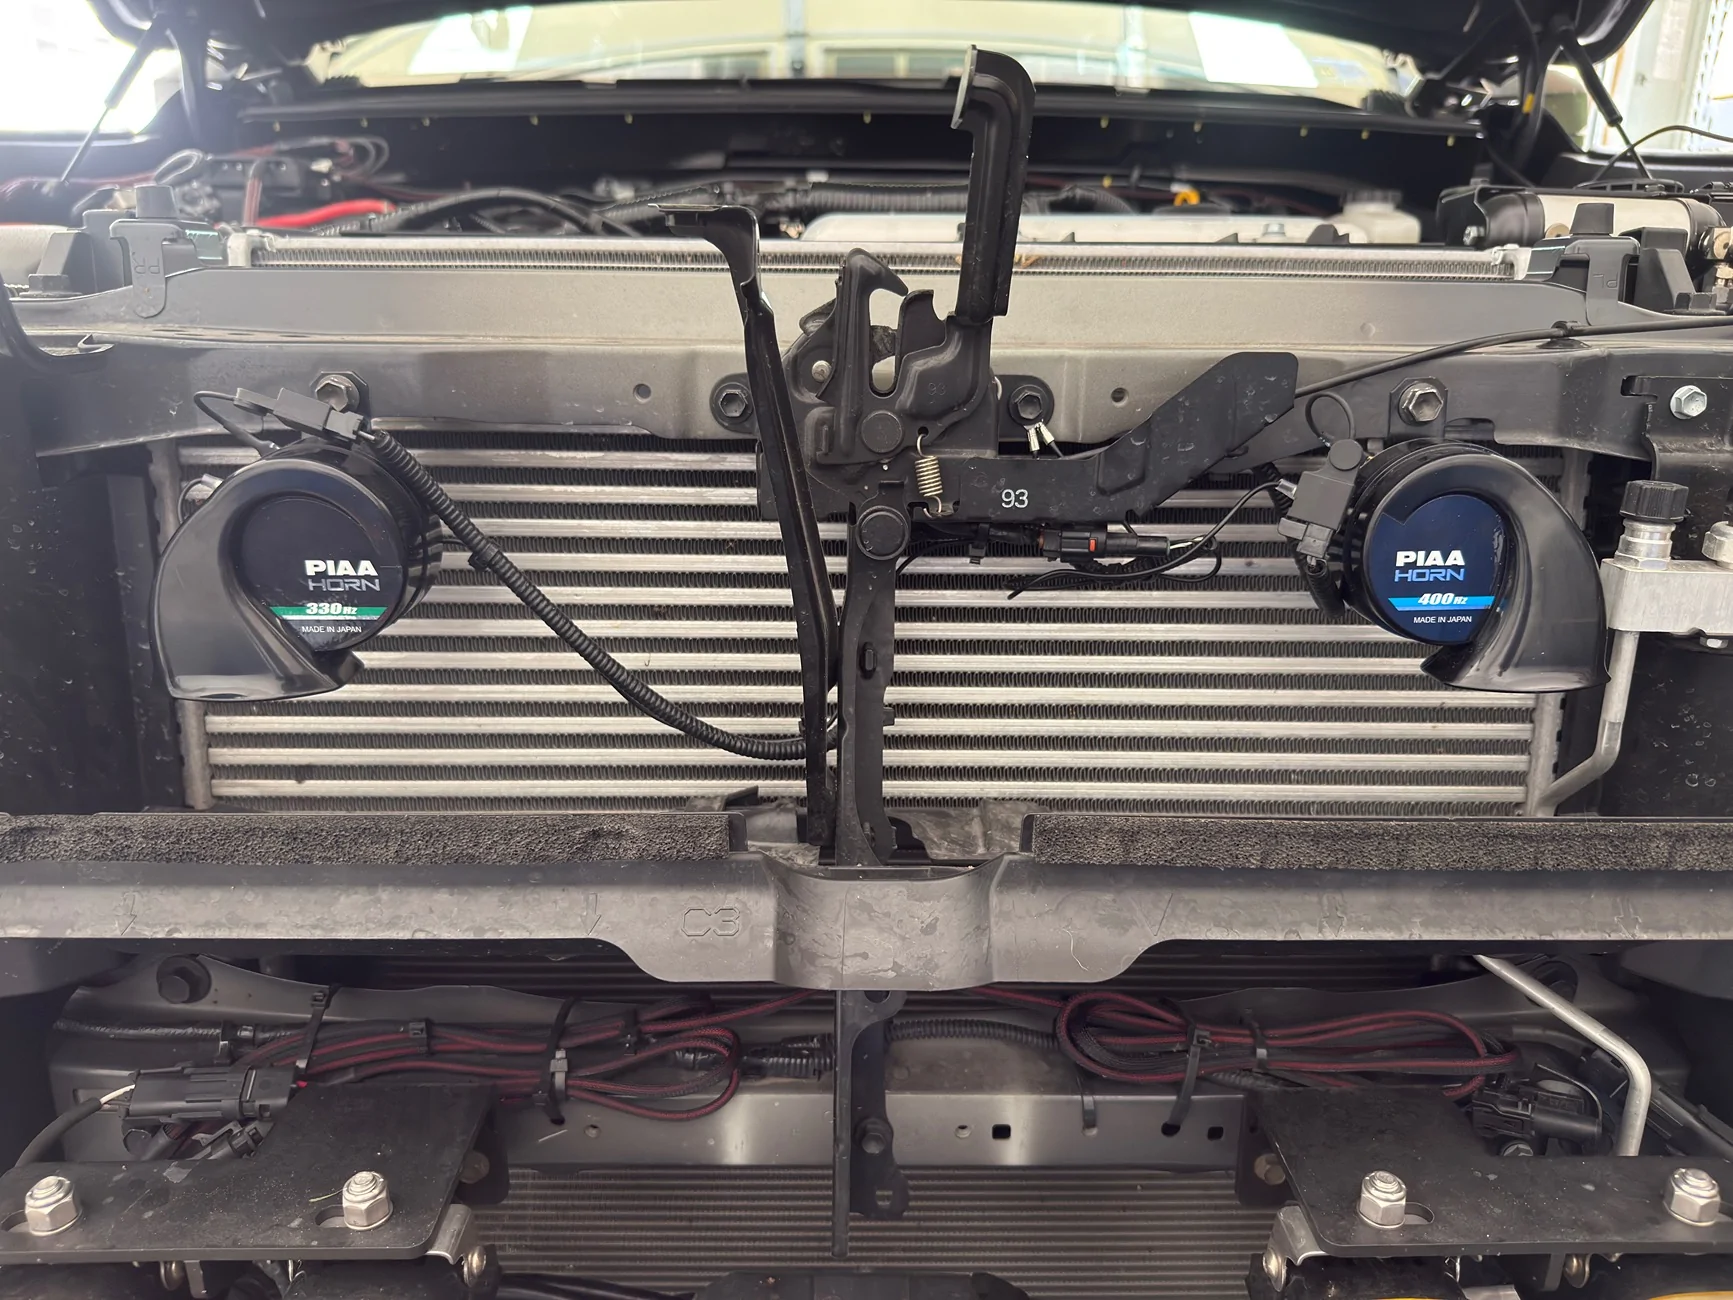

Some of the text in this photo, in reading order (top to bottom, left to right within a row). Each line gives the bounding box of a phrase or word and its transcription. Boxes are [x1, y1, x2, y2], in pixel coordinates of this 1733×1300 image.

[1001, 488, 1029, 508] 93
[1395, 549, 1466, 567] PIAA
[304, 559, 379, 576] PIAA
[1394, 568, 1465, 582] HORN
[307, 578, 381, 592] HORN
[1413, 615, 1473, 624] MADE IN JAPAN
[301, 625, 362, 633] MADE IN JAPAN
[681, 906, 741, 937] C3
